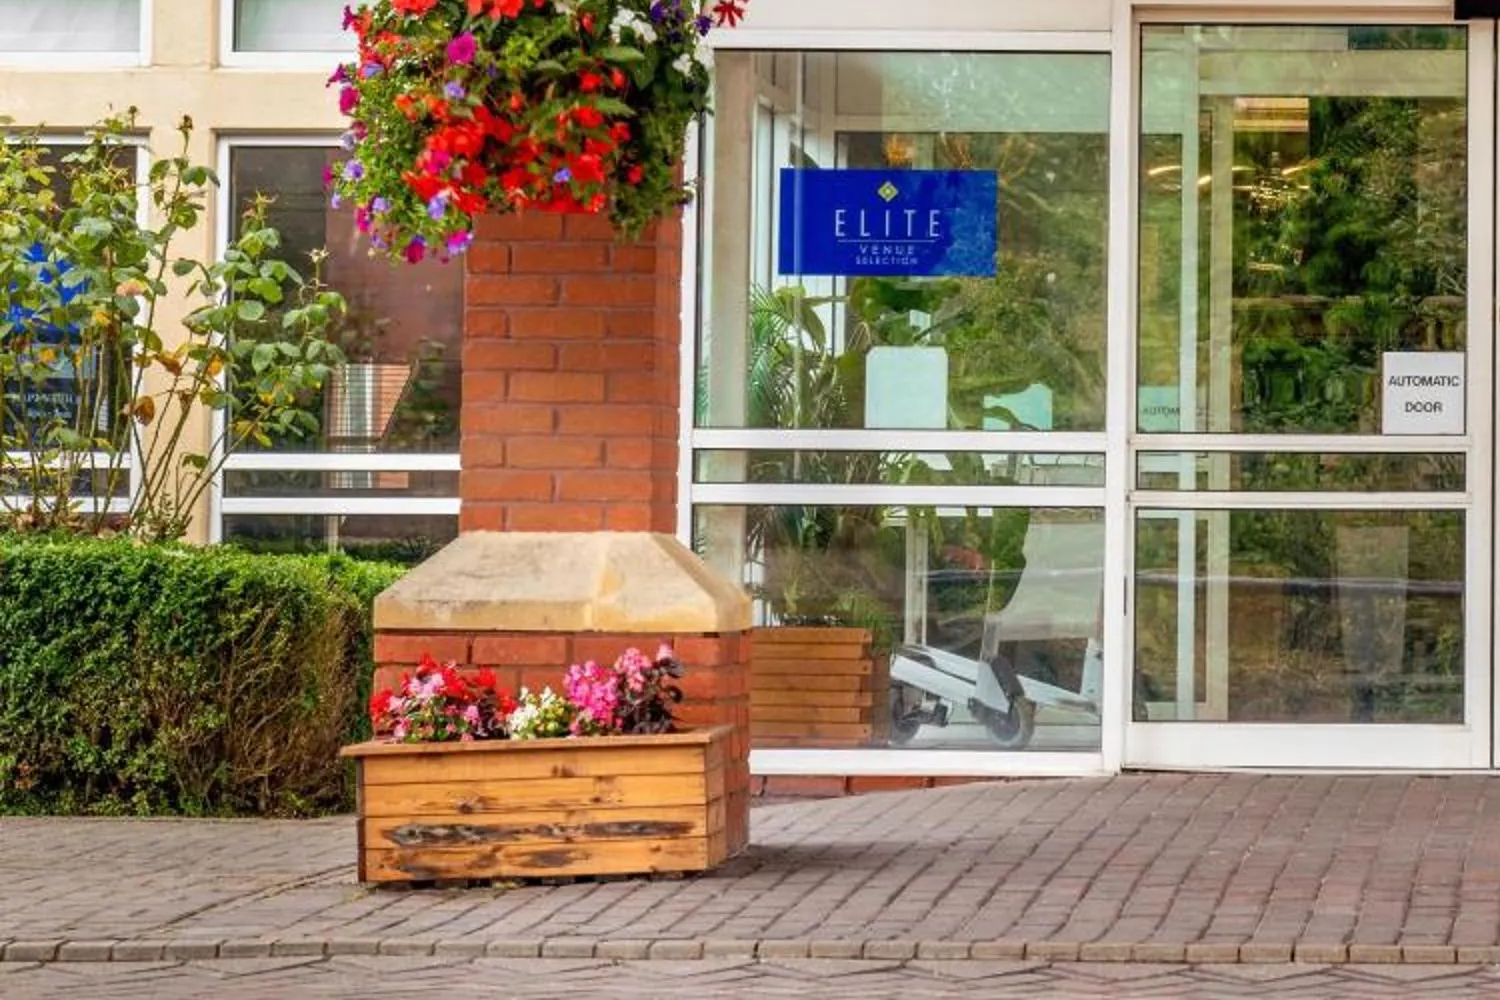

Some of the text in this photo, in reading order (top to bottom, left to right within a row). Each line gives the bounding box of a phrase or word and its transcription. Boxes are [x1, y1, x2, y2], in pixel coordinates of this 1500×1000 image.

[835, 208, 941, 237] ELITE
[859, 244, 915, 255] VENUE
[855, 256, 918, 265] SELECTION
[1388, 375, 1461, 388] AUTOMATIC
[1404, 402, 1443, 414] DOOR
